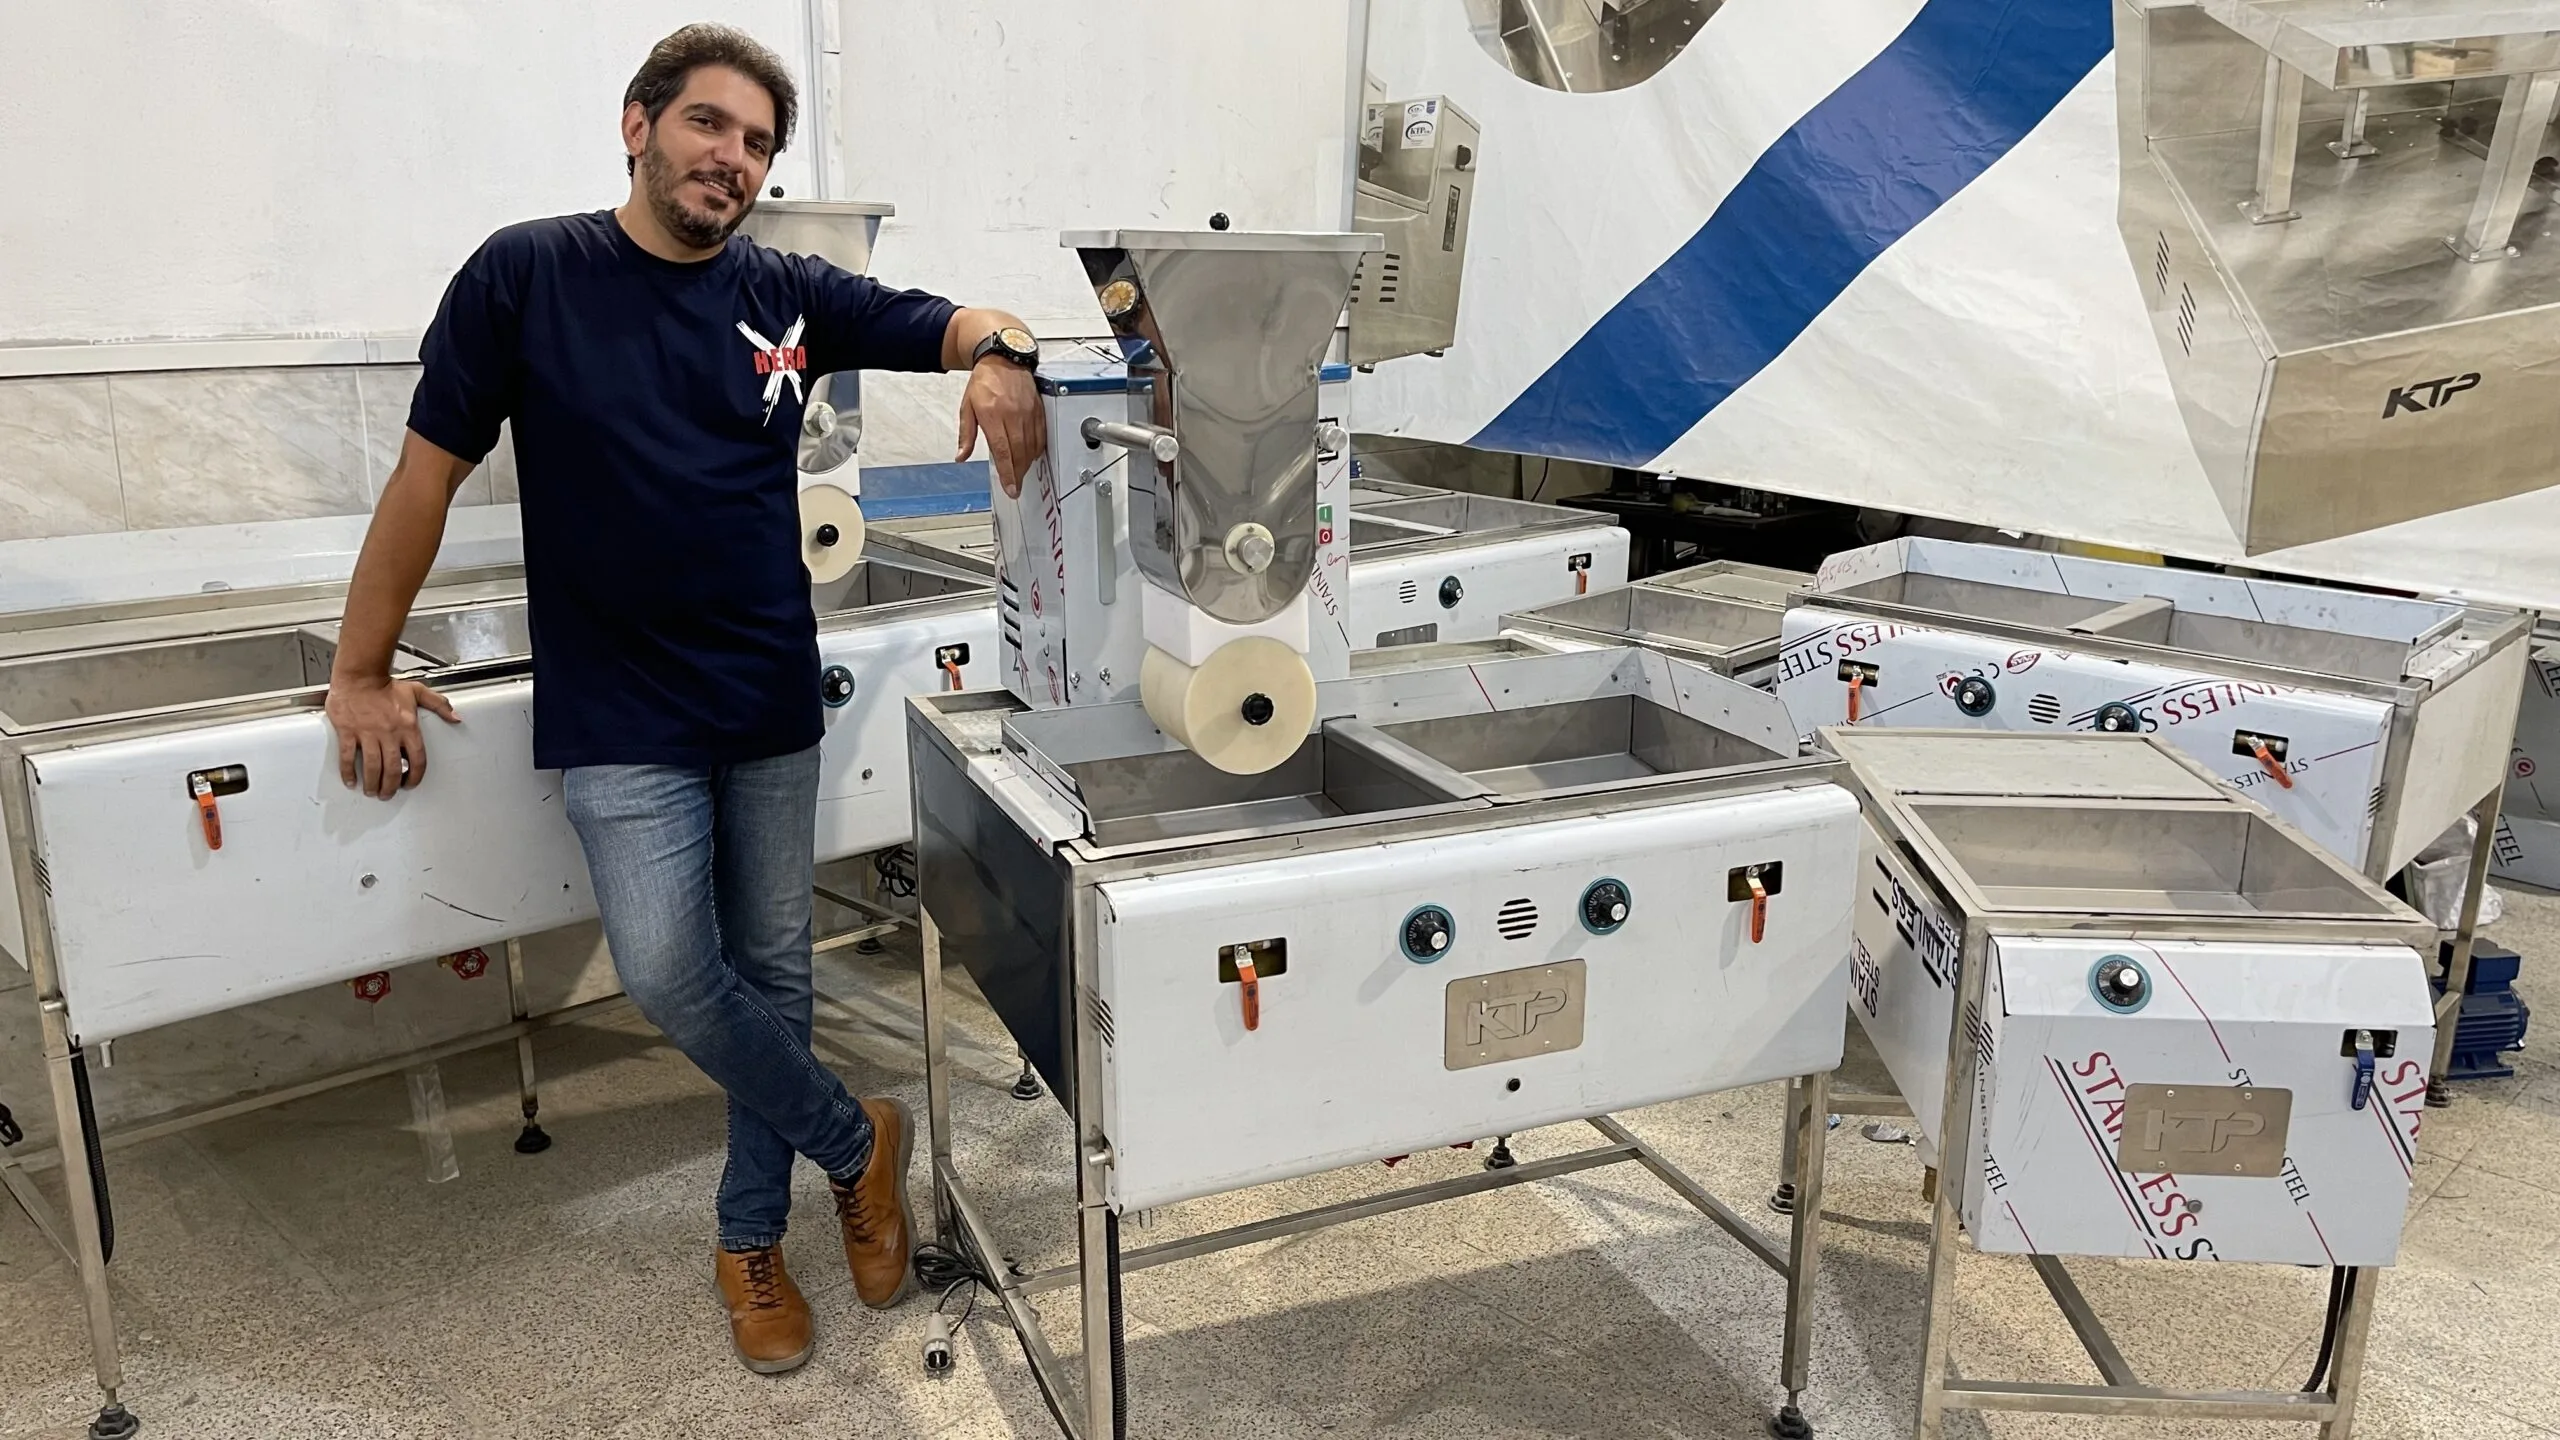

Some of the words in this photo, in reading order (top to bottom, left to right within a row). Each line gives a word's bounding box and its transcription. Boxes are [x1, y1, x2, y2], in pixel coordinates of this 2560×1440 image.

[1410, 126, 1426, 135] KTP
[754, 346, 807, 374] HERA
[2382, 372, 2481, 419] KTP
[1312, 564, 1339, 617] STAINL
[1777, 641, 1833, 684] STEE
[1850, 954, 1878, 1019] STAIN
[1857, 937, 1881, 988] STEEL
[1466, 987, 1568, 1046] KTP
[2072, 1051, 2198, 1237] STAESS
[2143, 1108, 2266, 1154] KTP
[2281, 1156, 2311, 1207] STEEL
